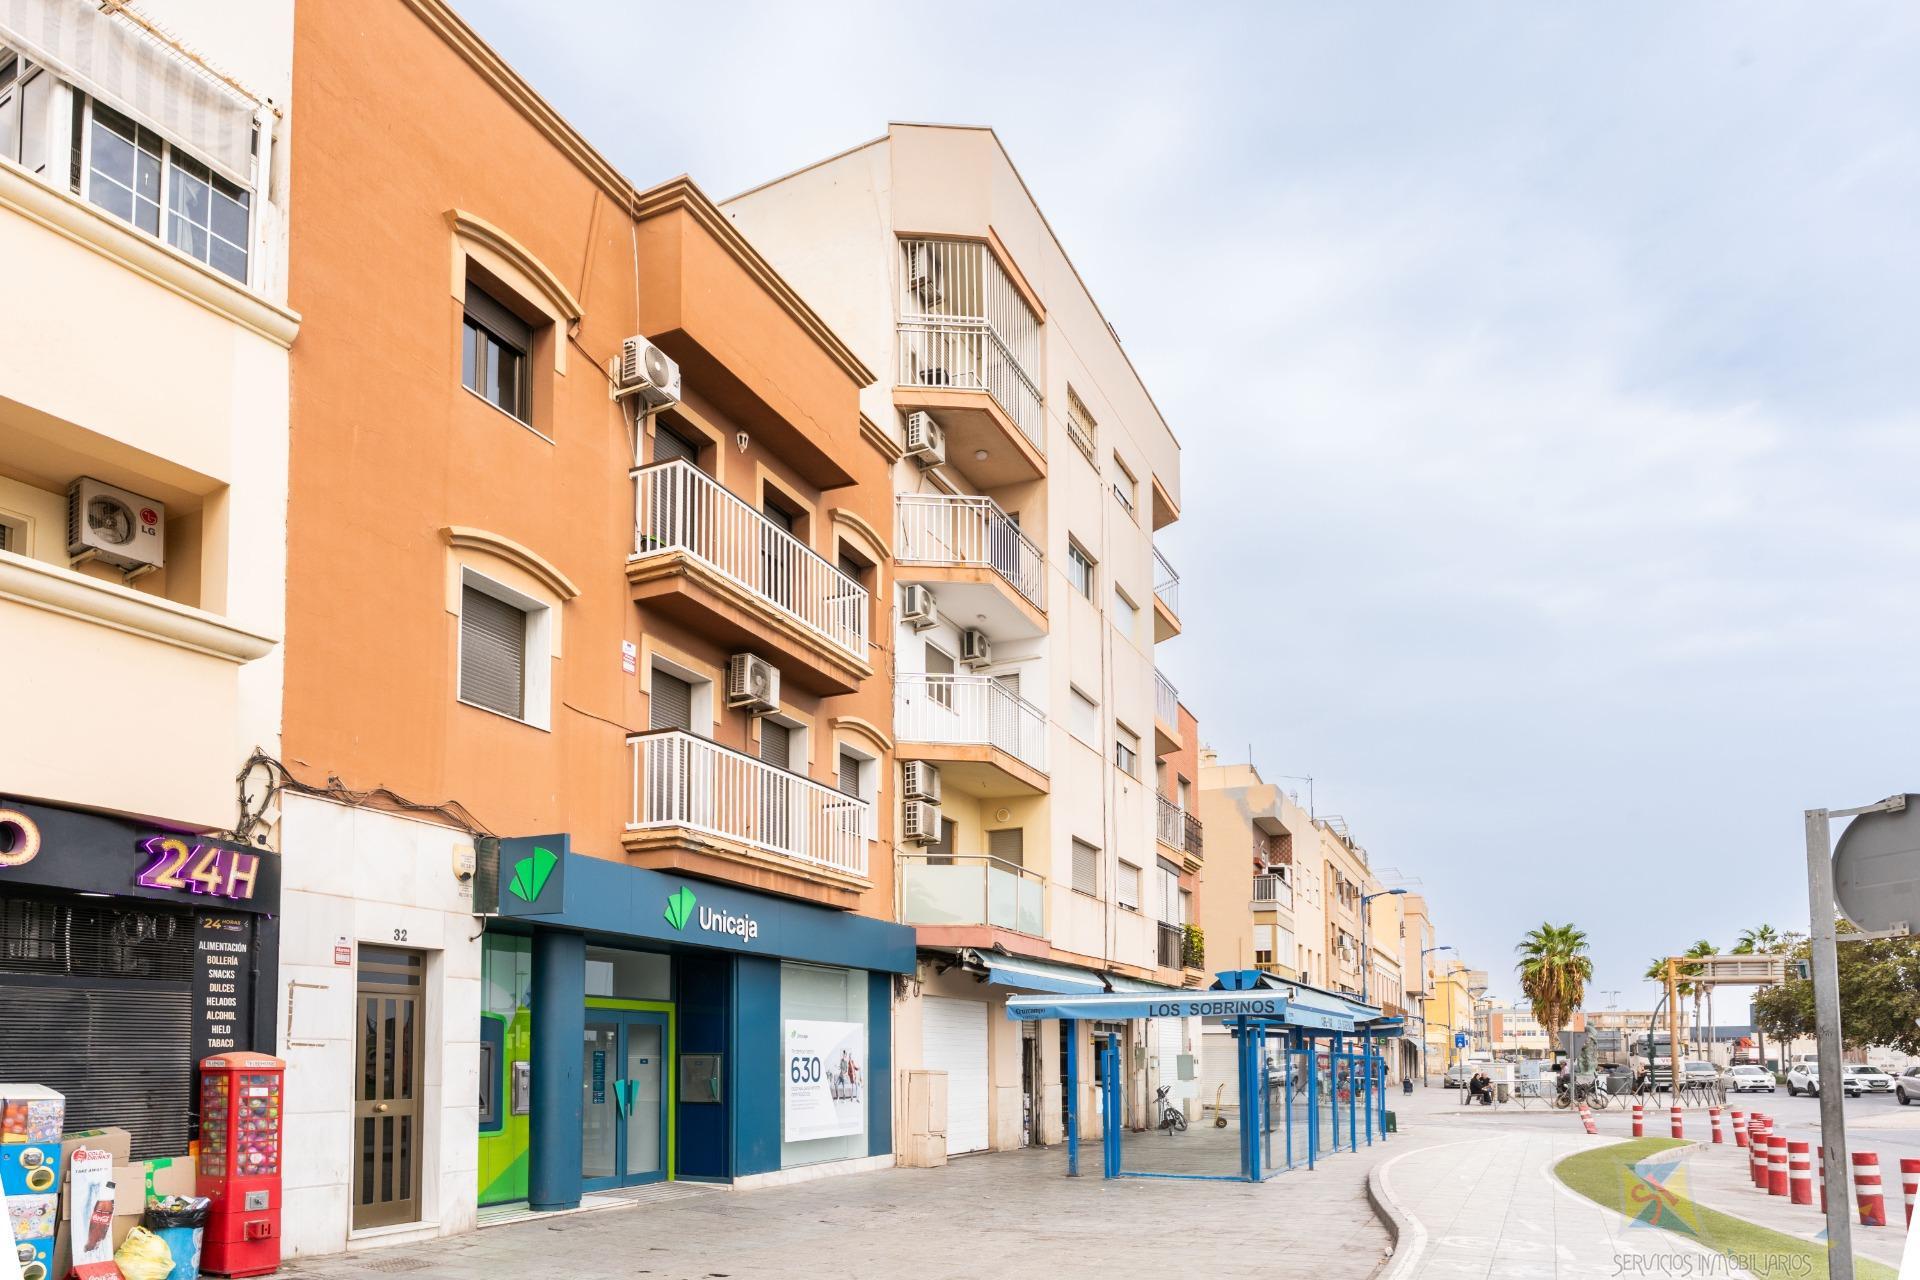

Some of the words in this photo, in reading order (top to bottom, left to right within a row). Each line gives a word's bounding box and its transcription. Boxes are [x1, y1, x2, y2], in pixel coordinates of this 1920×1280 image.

[141, 525, 156, 536] LG
[146, 837, 260, 899] 24H
[203, 918, 221, 929] 24
[699, 906, 758, 943] Unicaja
[394, 928, 408, 942] 32
[198, 941, 247, 953] ALIMENTACIÓN
[206, 955, 239, 966] BOLLERÍA
[208, 969, 236, 979] SNACKS
[209, 983, 235, 993] DULCES
[206, 996, 237, 1007] HELADOS
[1149, 1004, 1180, 1017] LOS
[1189, 1000, 1275, 1016] SOBRINOS
[206, 1010, 237, 1021] ALCOHOL
[211, 1024, 231, 1034] HIELO
[207, 1038, 234, 1048] TABACO
[791, 1057, 821, 1083] 630
